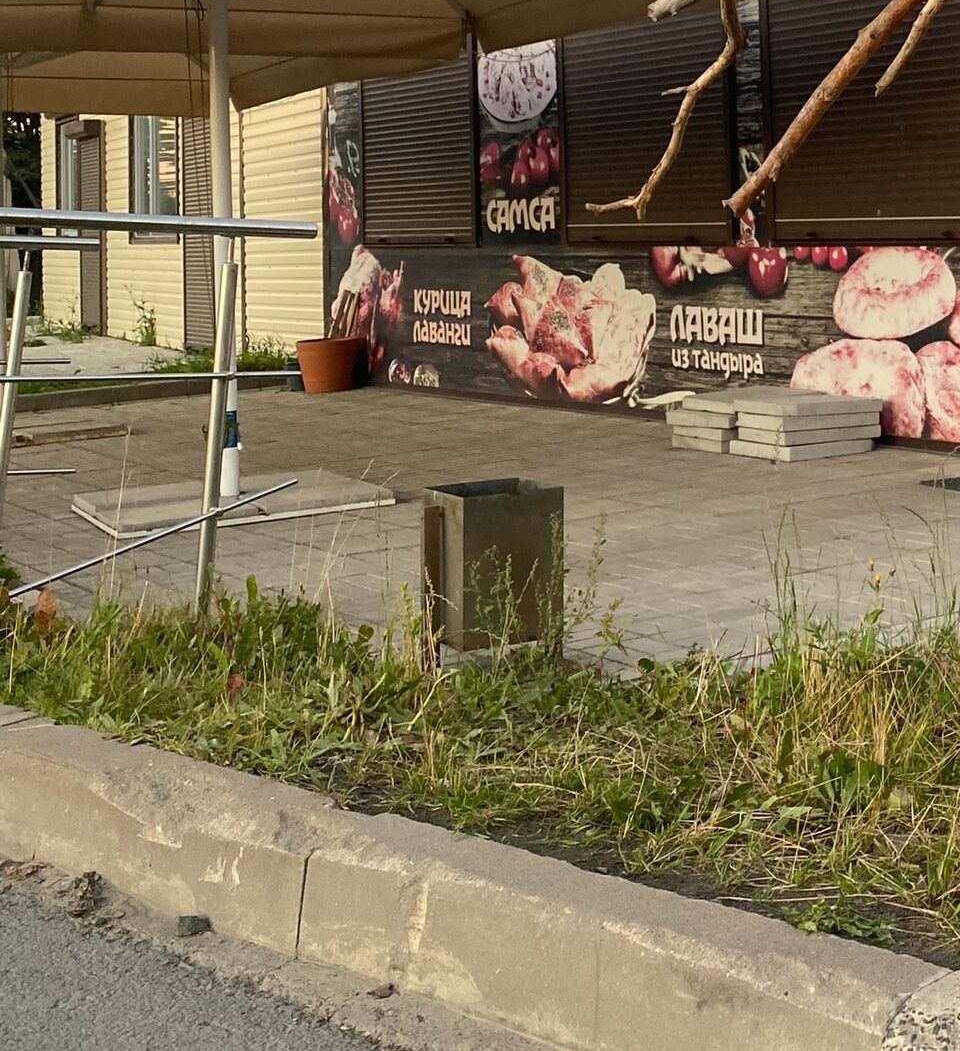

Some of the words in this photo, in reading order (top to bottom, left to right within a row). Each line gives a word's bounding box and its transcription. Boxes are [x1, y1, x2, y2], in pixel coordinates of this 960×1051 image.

[486, 196, 557, 234] САМСА
[413, 288, 472, 319] КУРИЦА
[670, 304, 763, 346] ЛАВАШ
[671, 348, 690, 369] из
[691, 348, 764, 380] тандыра
